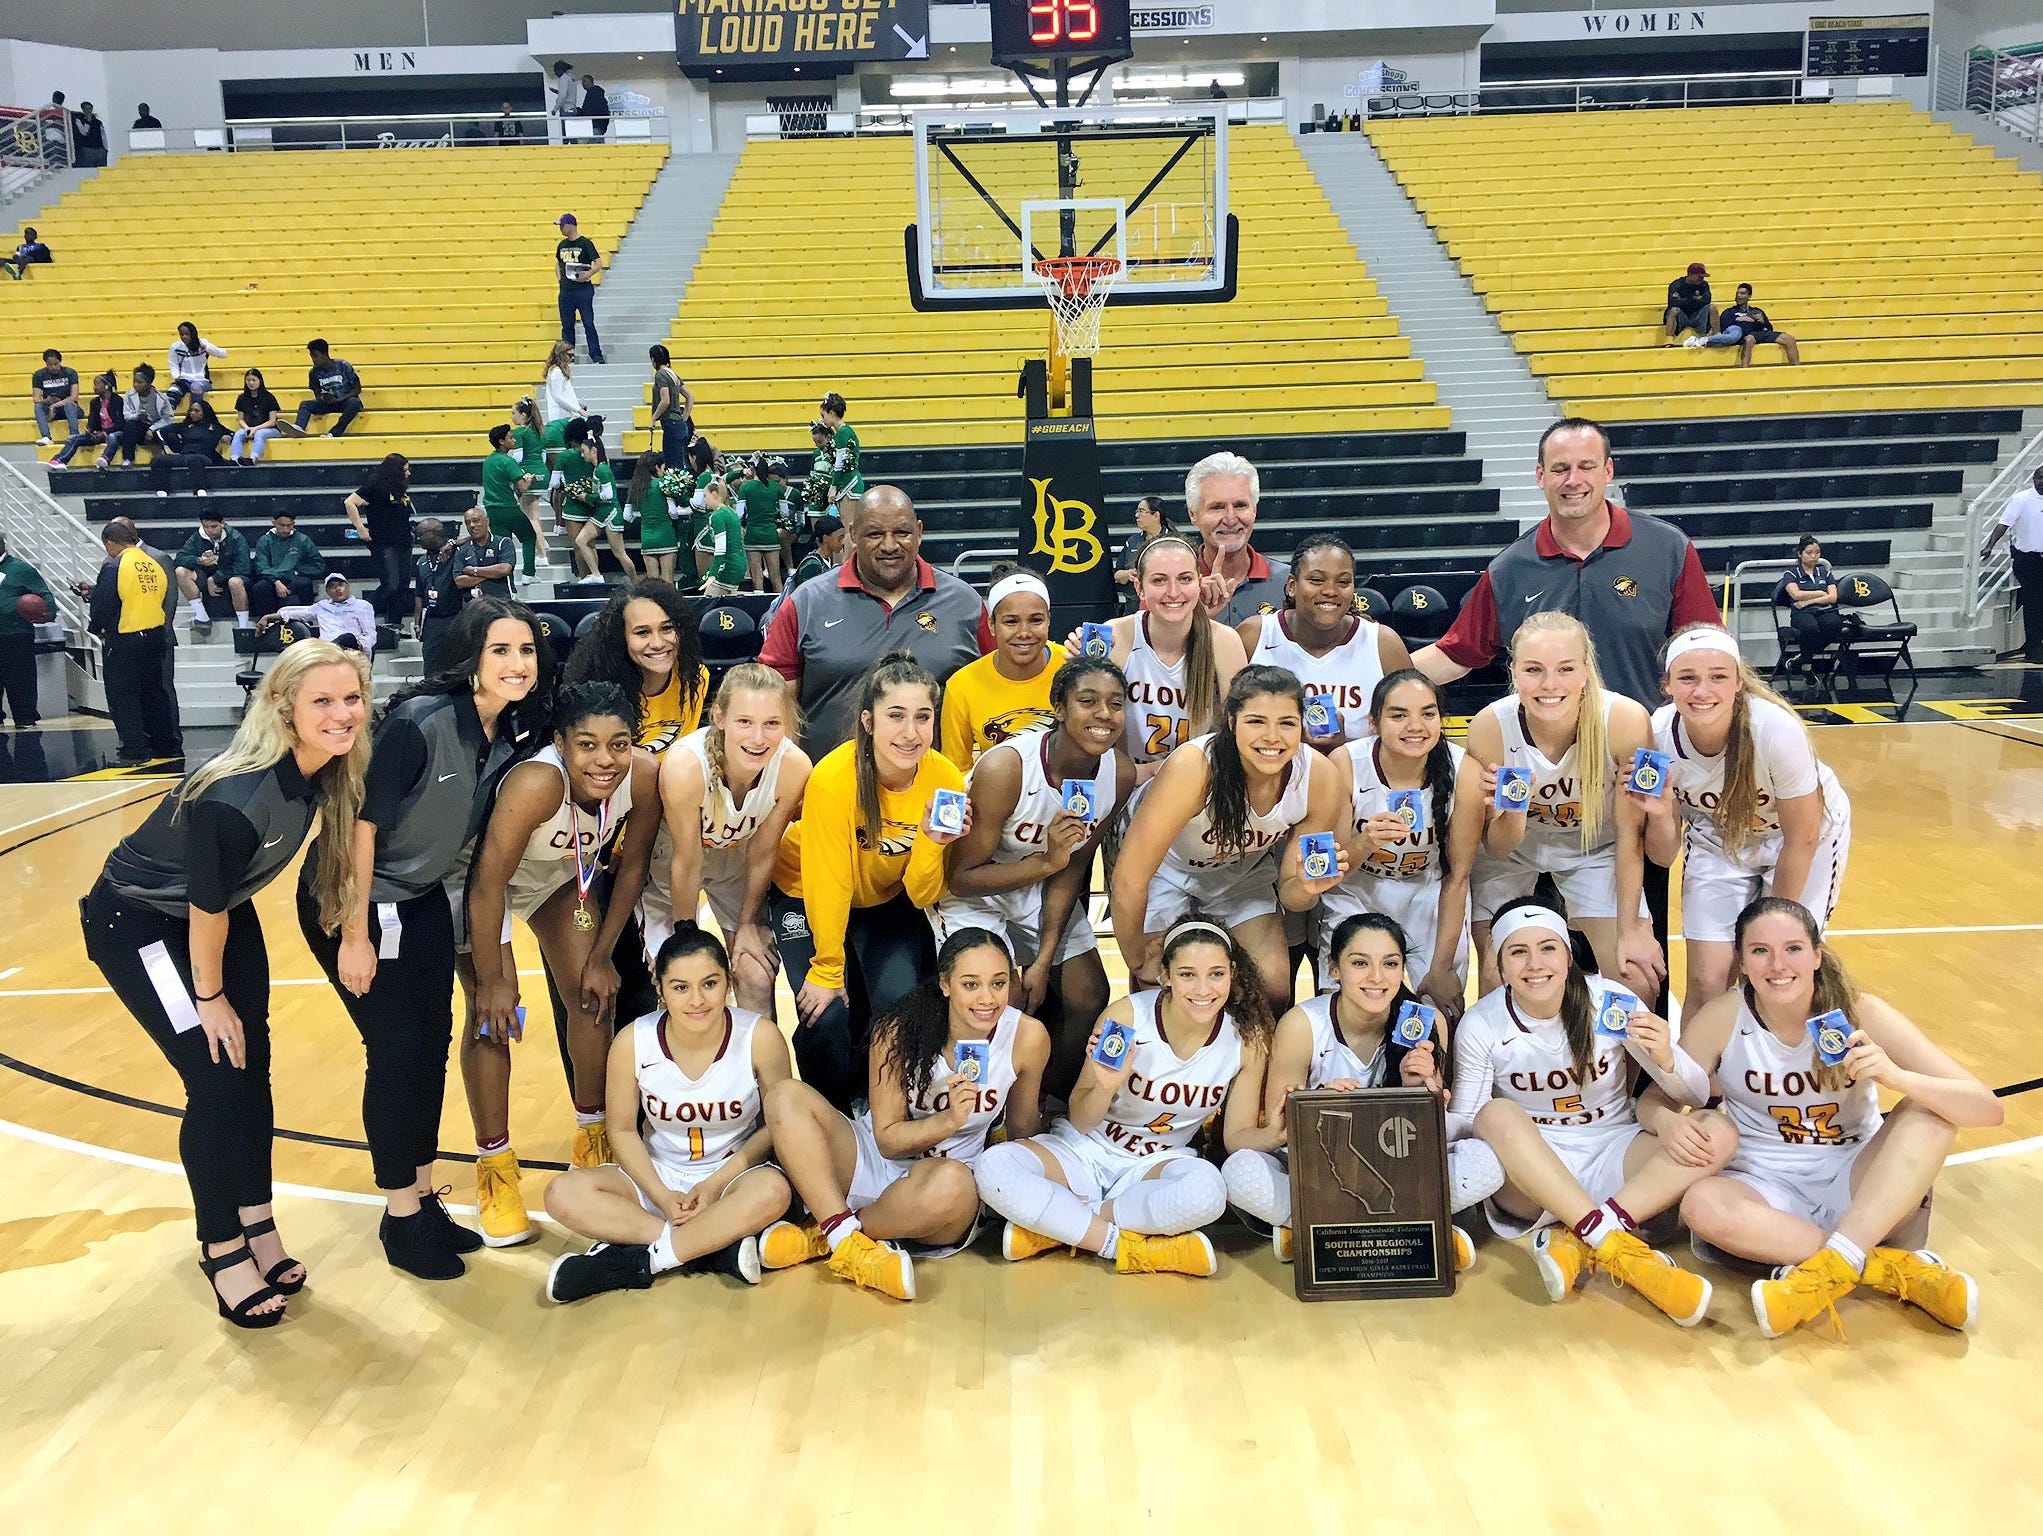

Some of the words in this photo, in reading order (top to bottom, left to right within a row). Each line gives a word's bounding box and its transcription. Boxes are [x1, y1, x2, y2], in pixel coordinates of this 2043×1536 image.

[1029, 0, 1096, 42] 35
[1131, 8, 1212, 28] CESSIONS
[1582, 12, 1705, 32] WOMEN
[700, 15, 783, 54] LOUD
[794, 12, 878, 51] HERE
[354, 52, 415, 70] MEN
[1031, 424, 1090, 434] #GOBEACH
[1028, 477, 1104, 576] LB
[134, 562, 155, 572] CSC
[138, 575, 158, 583] EENT
[1852, 577, 1871, 597] LB
[1410, 589, 1428, 610] LB
[540, 621, 551, 637] B
[719, 610, 735, 630] LB
[1127, 681, 1188, 710] CLOV
[1303, 683, 1362, 708] OVIS
[550, 827, 612, 850] CLOV
[1128, 1072, 1224, 1108] CLOVIS
[1745, 1070, 1857, 1097] CLOV
[646, 1094, 743, 1122] CLOVIS
[907, 1088, 998, 1114] LOIS
[687, 1126, 705, 1161] 1
[1378, 1117, 1417, 1159] CIF
[1316, 1228, 1347, 1236] California
[1324, 1240, 1375, 1249] SOUTHERN
[1376, 1239, 1423, 1248] REGIONAL
[1336, 1248, 1413, 1258] CHAMPIONSHIPS
